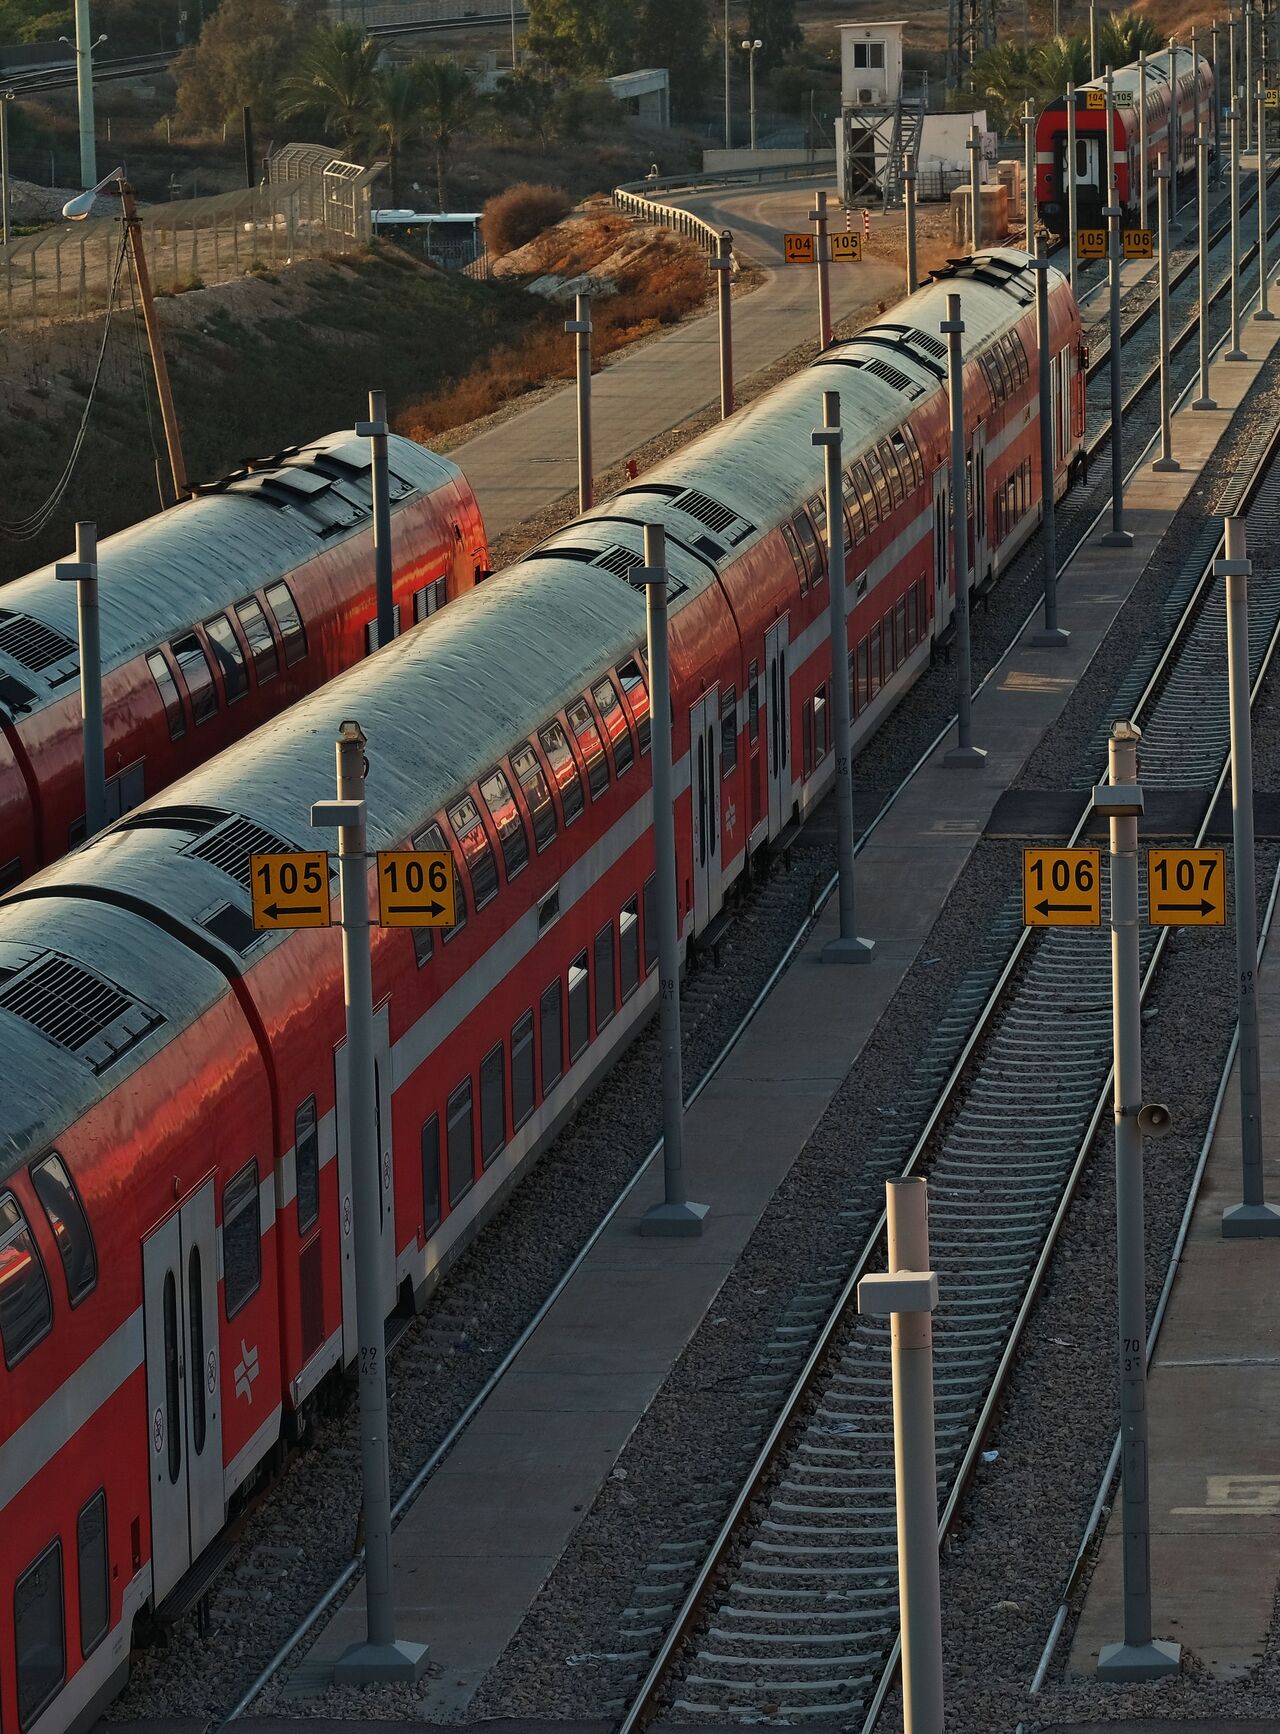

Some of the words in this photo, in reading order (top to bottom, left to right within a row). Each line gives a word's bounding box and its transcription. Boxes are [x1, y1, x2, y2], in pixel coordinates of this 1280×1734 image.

[1088, 93, 1103, 101] 104
[1117, 93, 1131, 101] 105
[787, 238, 811, 250] 104
[834, 236, 858, 248] 105
[1080, 233, 1104, 245] 105
[1125, 233, 1149, 245] 106
[258, 862, 322, 894] 105
[384, 861, 448, 892] 106
[1031, 859, 1093, 891] 106
[1155, 859, 1217, 890] 107
[1240, 970, 1252, 982] 69
[661, 979, 674, 990] 98
[1123, 1339, 1140, 1352] 70
[360, 1346, 377, 1360] 99
